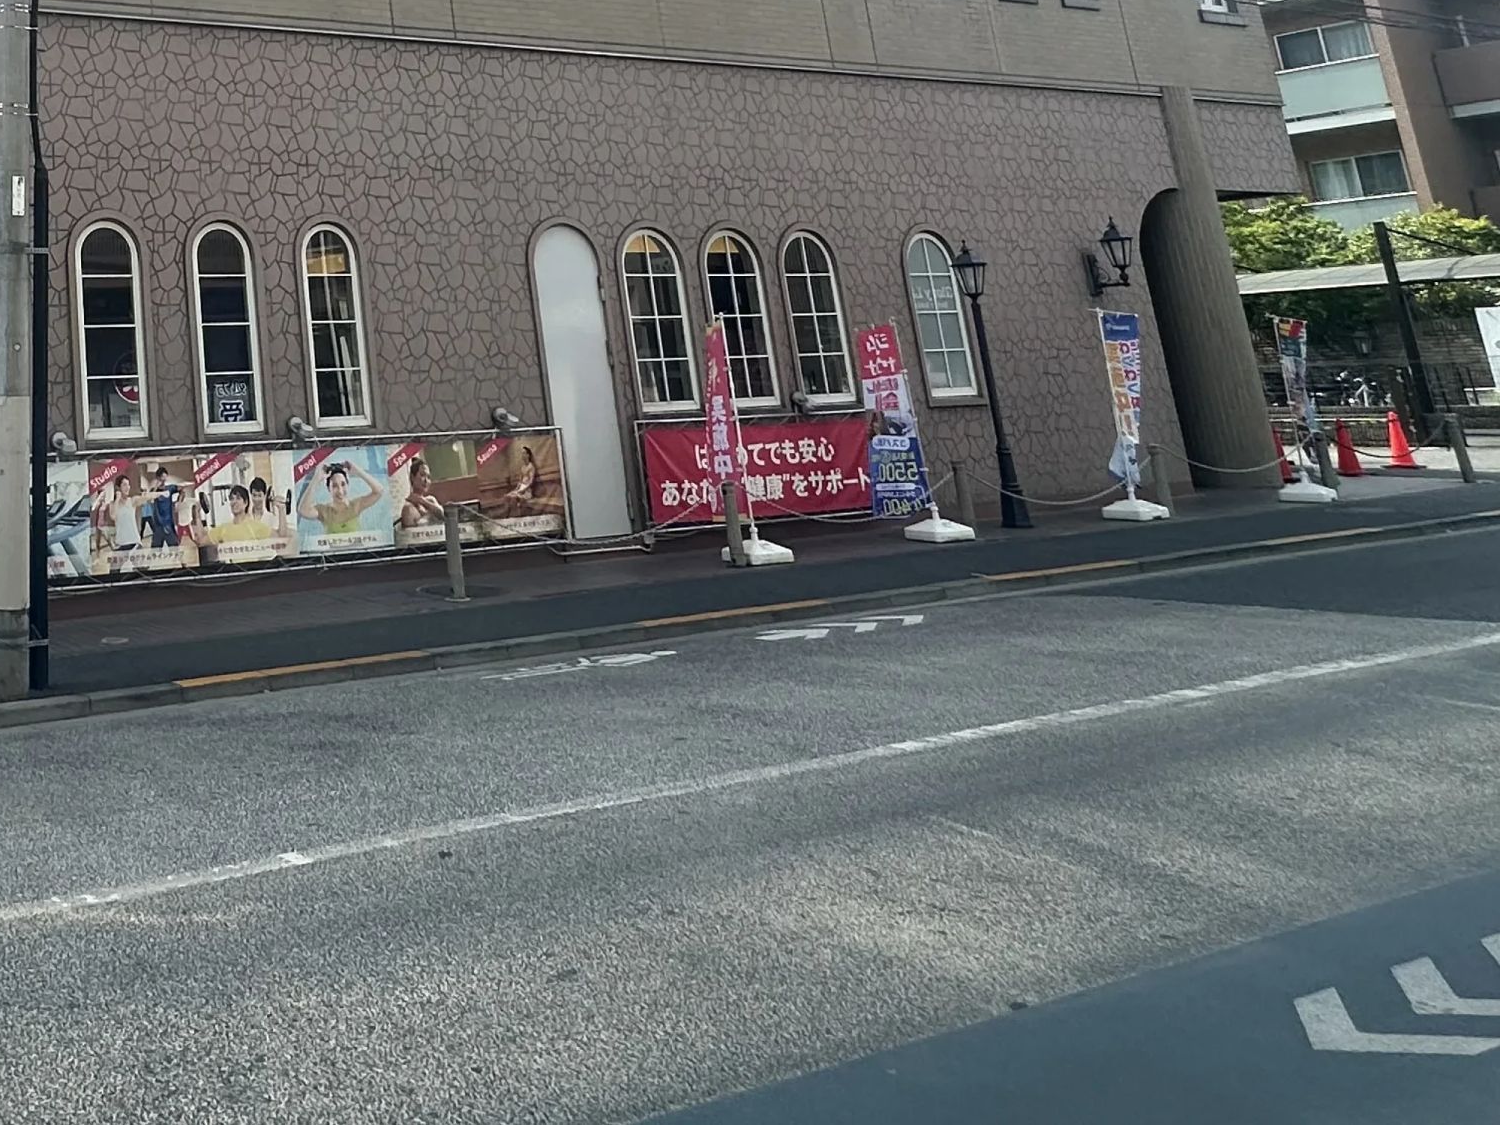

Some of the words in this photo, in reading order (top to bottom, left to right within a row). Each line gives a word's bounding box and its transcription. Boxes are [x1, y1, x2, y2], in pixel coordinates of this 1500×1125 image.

[392, 451, 407, 468] Spa
[477, 443, 498, 465] Sauna
[694, 436, 835, 470] はめてでも安心
[89, 464, 118, 489] Studio
[298, 457, 316, 475] Pool
